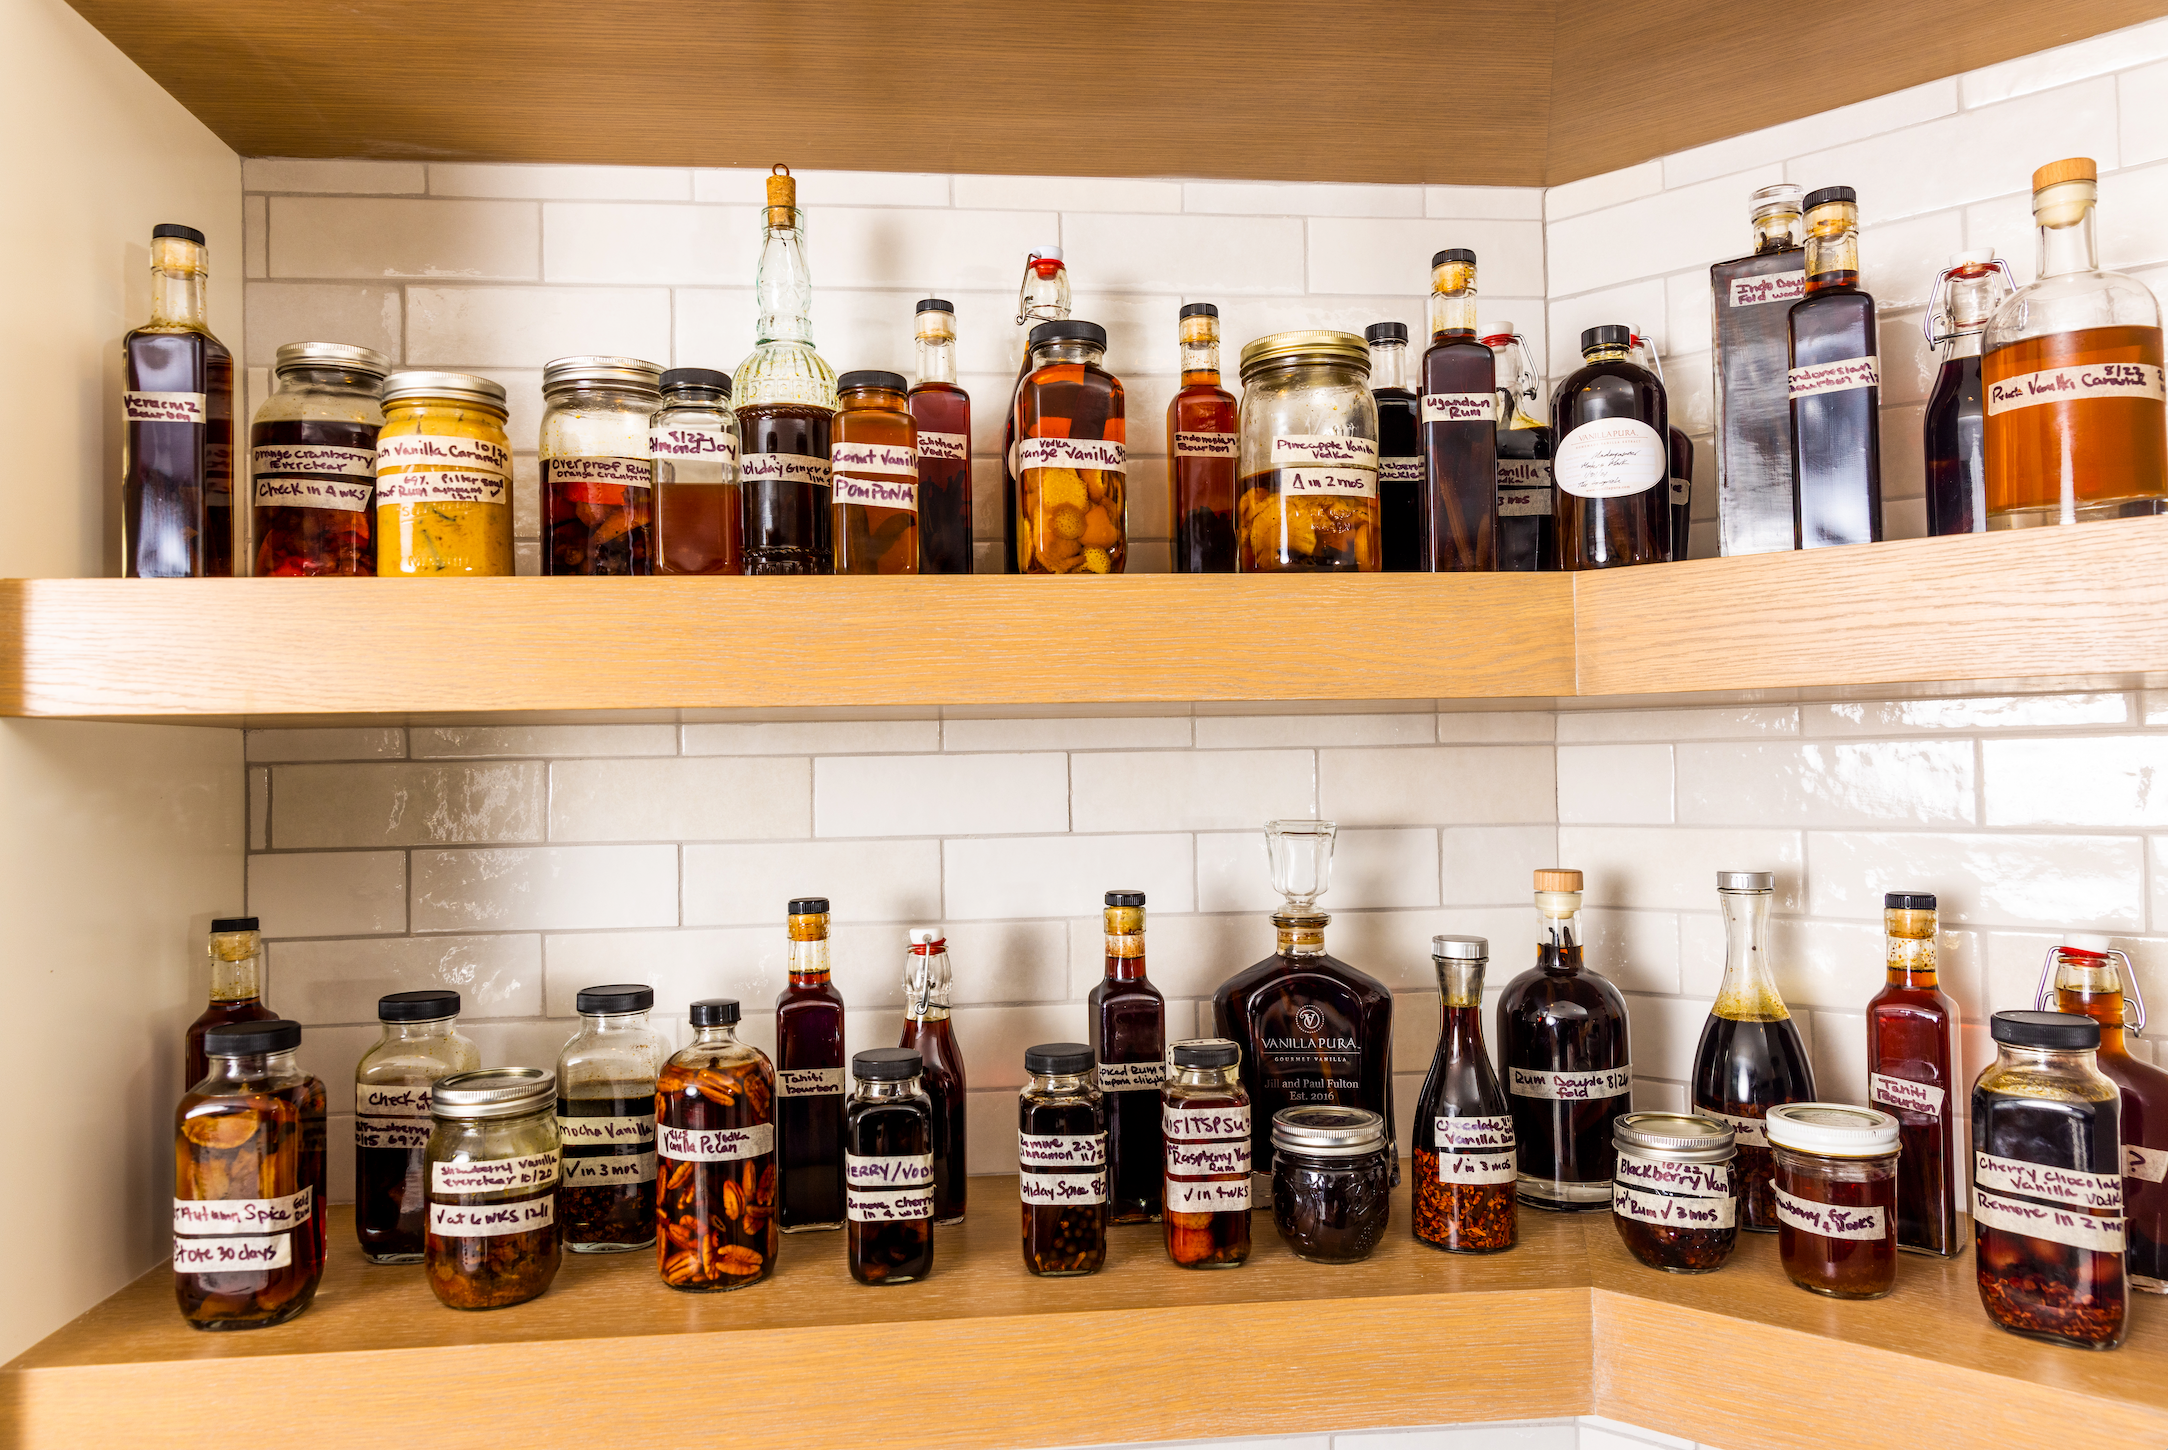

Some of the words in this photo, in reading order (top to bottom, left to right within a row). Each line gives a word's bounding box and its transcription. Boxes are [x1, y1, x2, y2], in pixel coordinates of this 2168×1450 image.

[1449, 406, 1481, 419] Rum
[1497, 464, 1539, 479] anilla
[1264, 1078, 1280, 1089] Jill
[1282, 1078, 1301, 1089] and
[1303, 1078, 1325, 1089] Paul
[1327, 1078, 1359, 1089] Fulton
[1289, 1091, 1308, 1101] Est.
[1310, 1091, 1335, 1101] 2016
